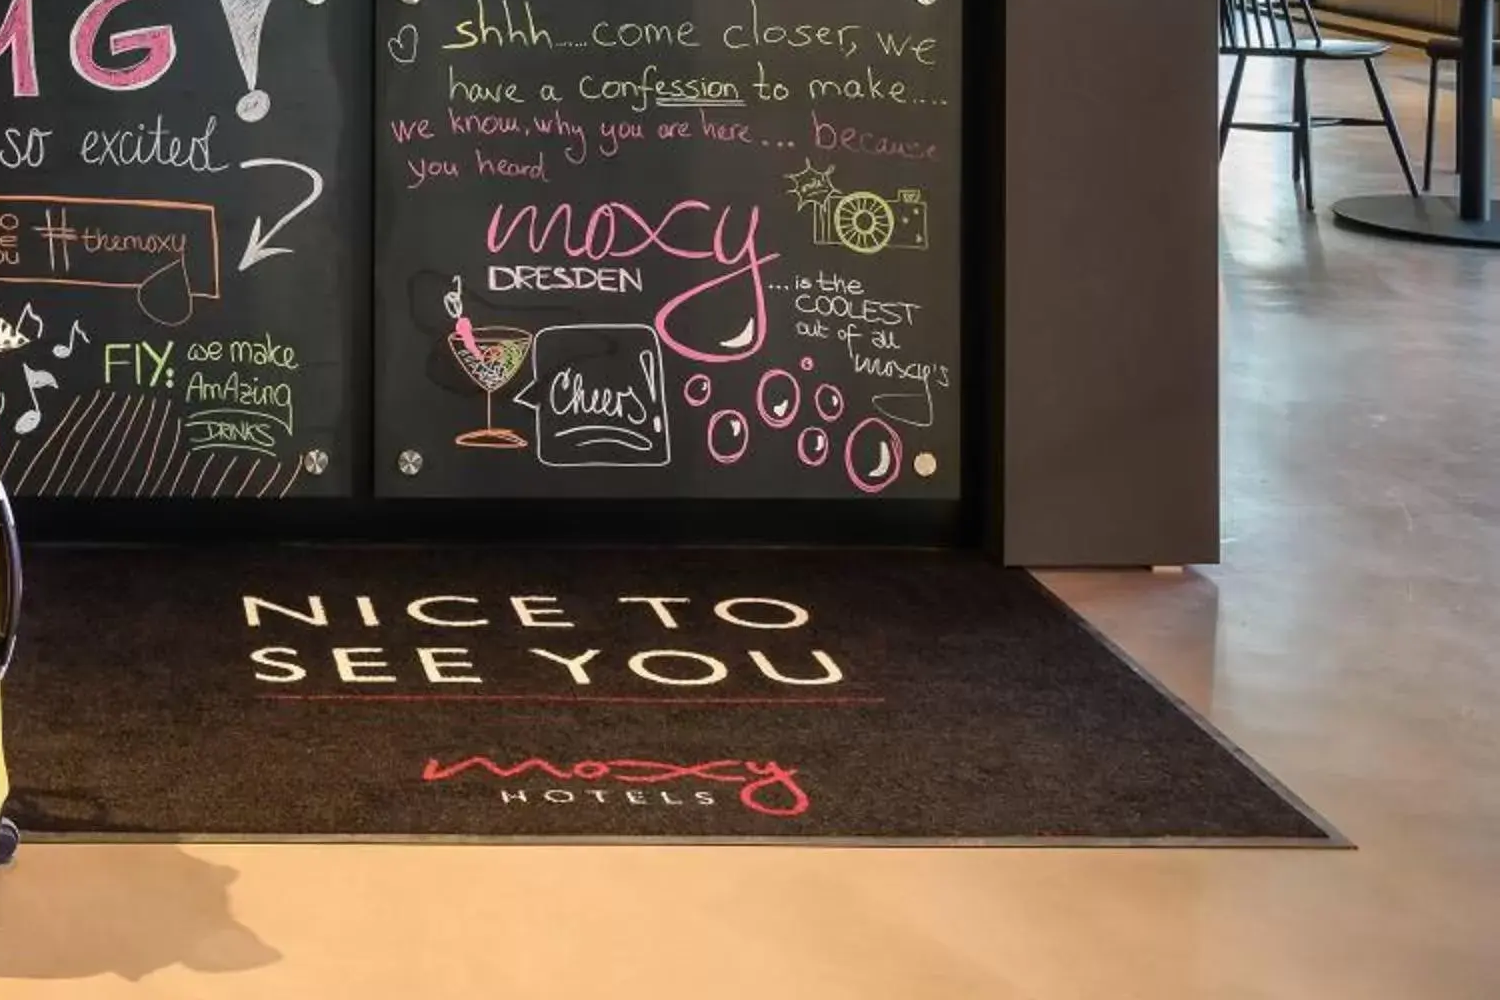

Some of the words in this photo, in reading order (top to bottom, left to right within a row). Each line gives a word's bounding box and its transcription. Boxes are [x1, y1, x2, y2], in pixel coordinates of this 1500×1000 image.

[876, 32, 937, 65] we
[449, 65, 524, 103] have
[540, 83, 563, 102] a
[579, 65, 740, 112] confession
[752, 60, 789, 101] to
[0, 127, 53, 169] so
[80, 115, 230, 173] excited
[600, 122, 644, 157] you
[657, 120, 693, 140] are
[407, 159, 459, 188] you
[476, 149, 548, 182] heard
[33, 206, 193, 308] #themoxy
[486, 199, 780, 363] moxy
[487, 265, 643, 292] DRESDEN
[816, 270, 864, 294] the
[795, 294, 922, 326] COOLEST
[187, 341, 223, 361] we
[230, 332, 299, 369] make
[795, 320, 829, 339] out
[837, 323, 863, 358] of
[871, 329, 900, 349] all
[185, 371, 293, 425] AmAzing
[550, 349, 662, 433] Cheers!
[242, 595, 574, 628] NICE
[618, 596, 809, 629] TO
[250, 647, 483, 683] SEE
[530, 648, 844, 686] YOU
[422, 756, 808, 816] moxy
[501, 791, 715, 806] HOTELS
